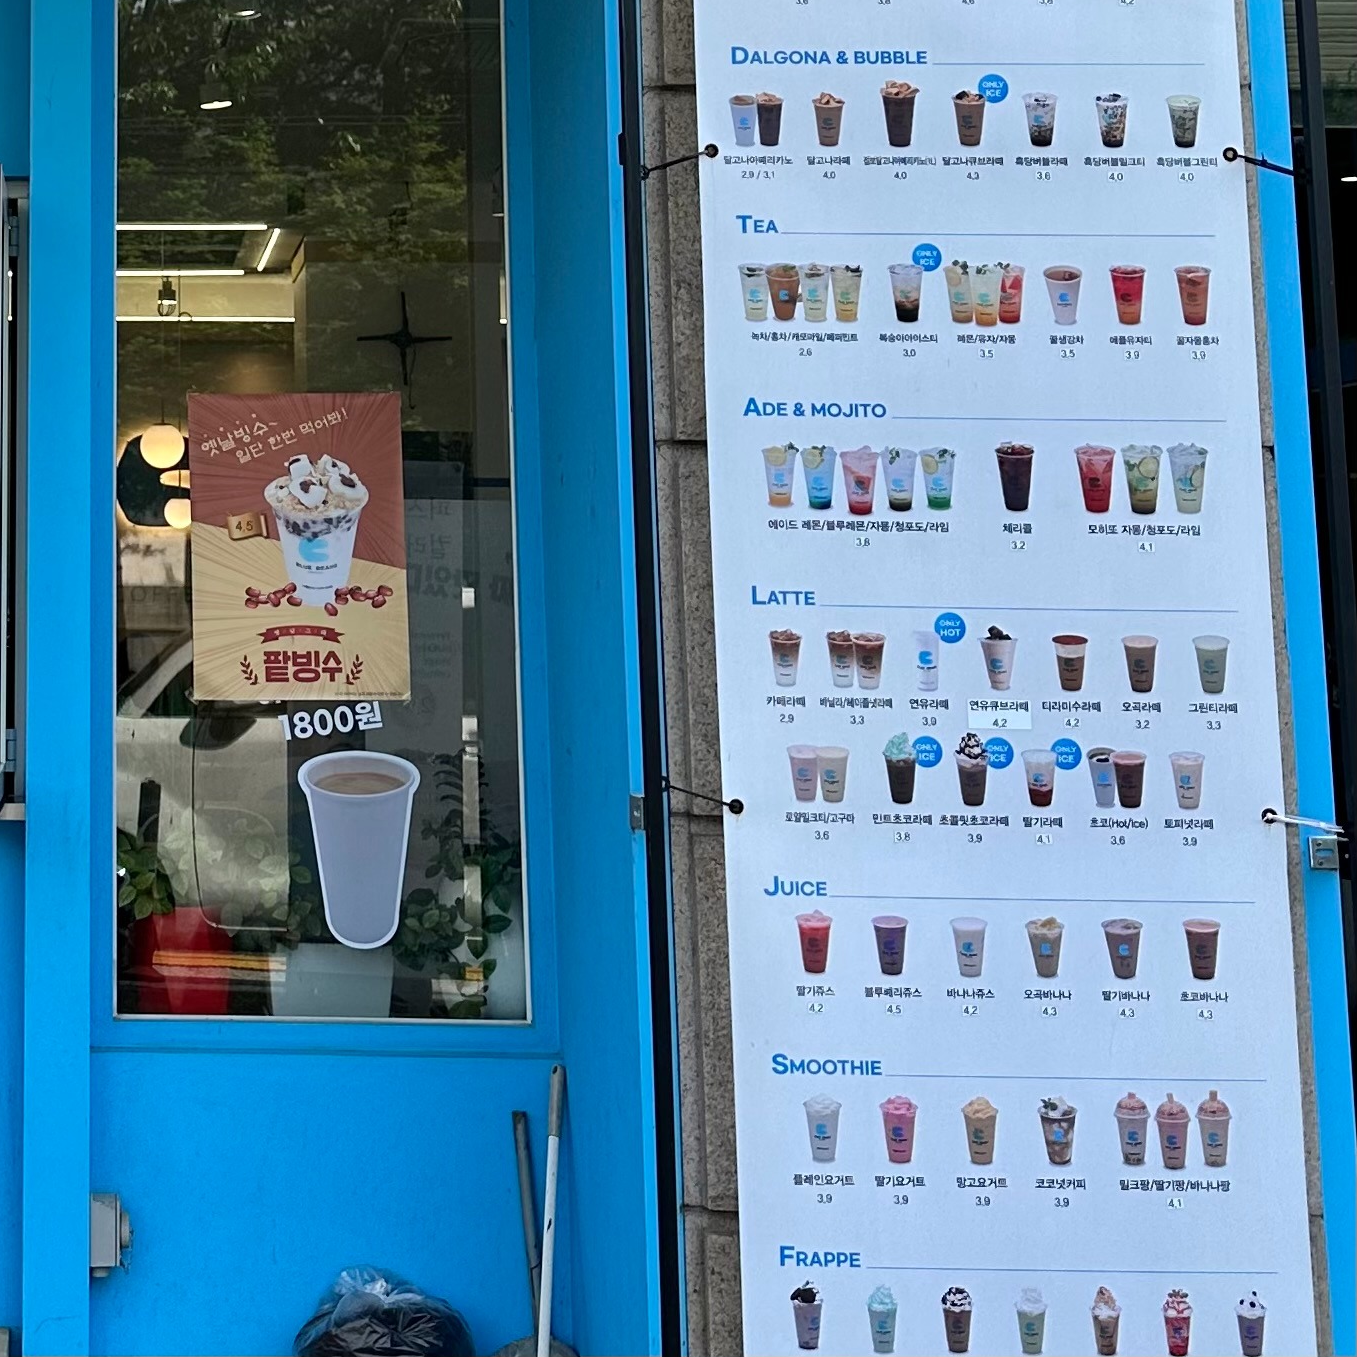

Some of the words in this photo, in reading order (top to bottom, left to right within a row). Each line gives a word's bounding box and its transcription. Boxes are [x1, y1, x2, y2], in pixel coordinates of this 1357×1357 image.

[731, 47, 831, 65] DALGONA
[836, 50, 848, 64] &
[854, 51, 927, 64] BUBBLE
[736, 215, 778, 233] TEA
[743, 397, 788, 416] ADE
[794, 403, 805, 417] &
[811, 403, 886, 418] MOJITO
[236, 442, 265, 463] 일단
[268, 428, 297, 450] 한번
[299, 407, 348, 434] 먹어봐!
[768, 519, 798, 529] 에이드
[1012, 541, 1026, 550] 3.2
[752, 586, 816, 605] LATTE
[940, 628, 960, 636] HOT
[263, 651, 343, 682] 팥빙수
[278, 701, 383, 741] 1800원
[993, 719, 1007, 728] 4.2
[1065, 719, 1079, 728] 4.2
[764, 876, 827, 896] JUICE
[772, 1053, 882, 1075] SMOOTHIE
[793, 1174, 855, 1186] 플레인요거트
[875, 1175, 926, 1187] 딸기요거트
[957, 1177, 1008, 1188] 망고요거트
[1035, 1178, 1086, 1190] 코코넛커피
[780, 1245, 861, 1268] FRAPPE
